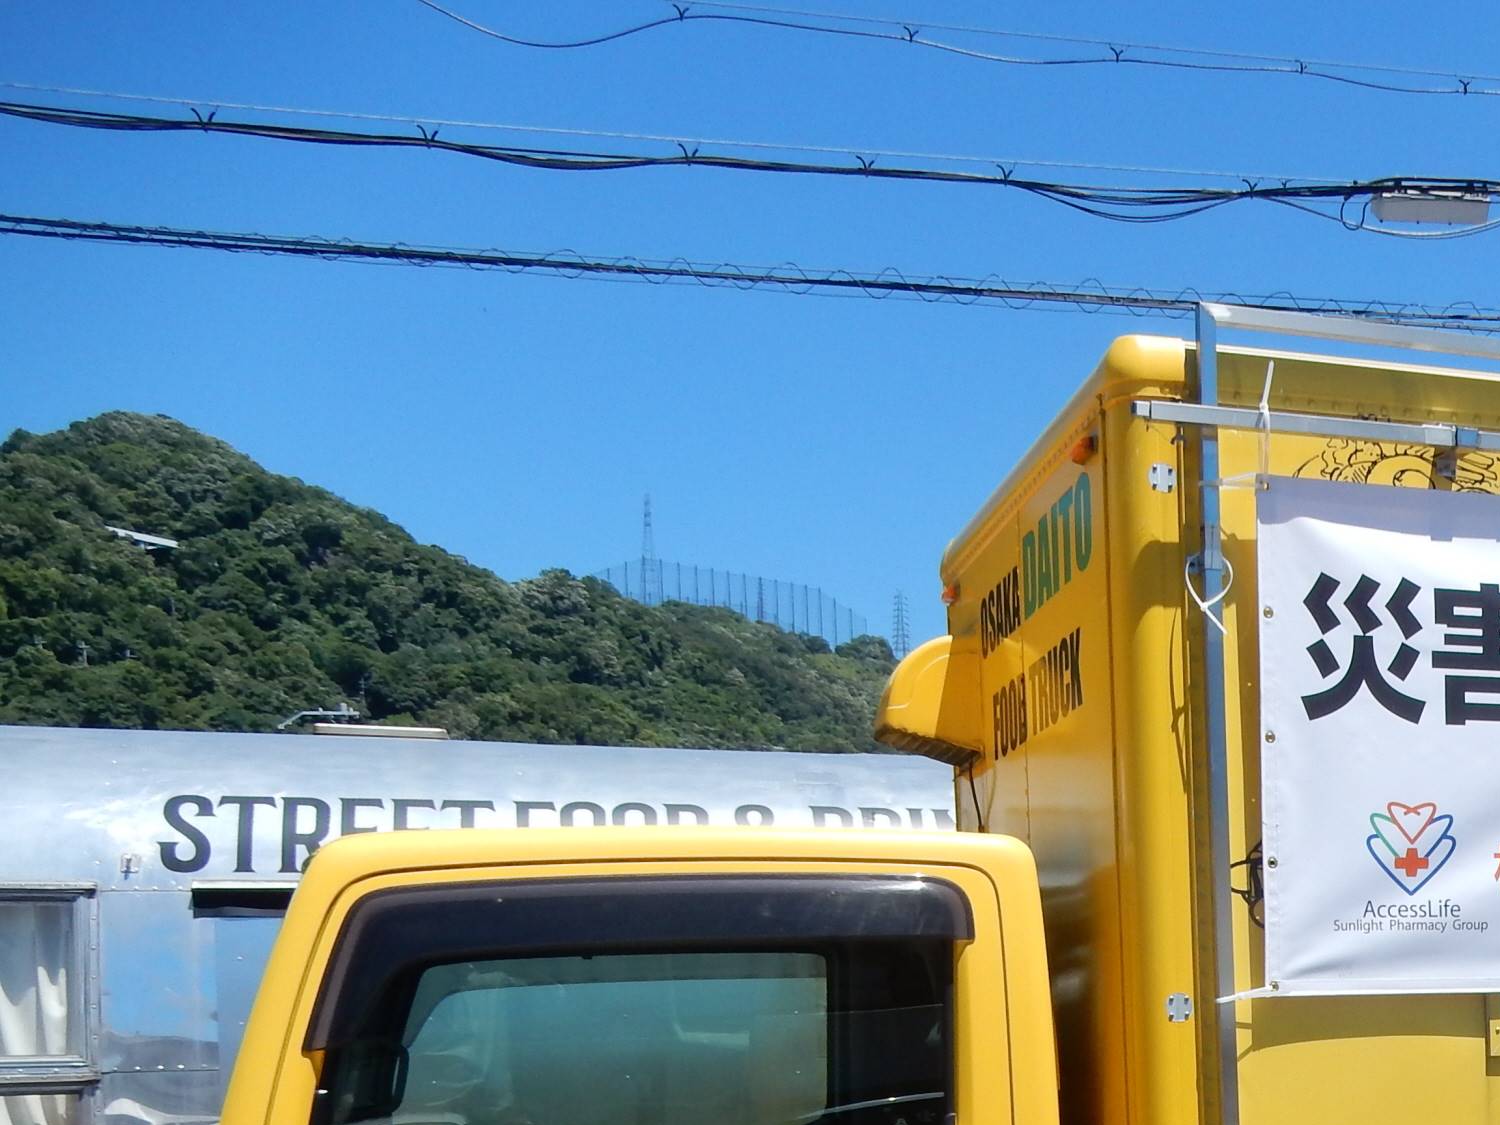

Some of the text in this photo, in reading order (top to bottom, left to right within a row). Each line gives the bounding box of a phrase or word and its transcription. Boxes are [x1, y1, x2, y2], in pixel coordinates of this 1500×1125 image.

[980, 471, 1092, 659] OSAKA DAITO
[1029, 627, 1083, 736] TRUCK
[1333, 919, 1489, 934] Sunlight Pharmacy Group
[1363, 899, 1461, 918] AccessLife
